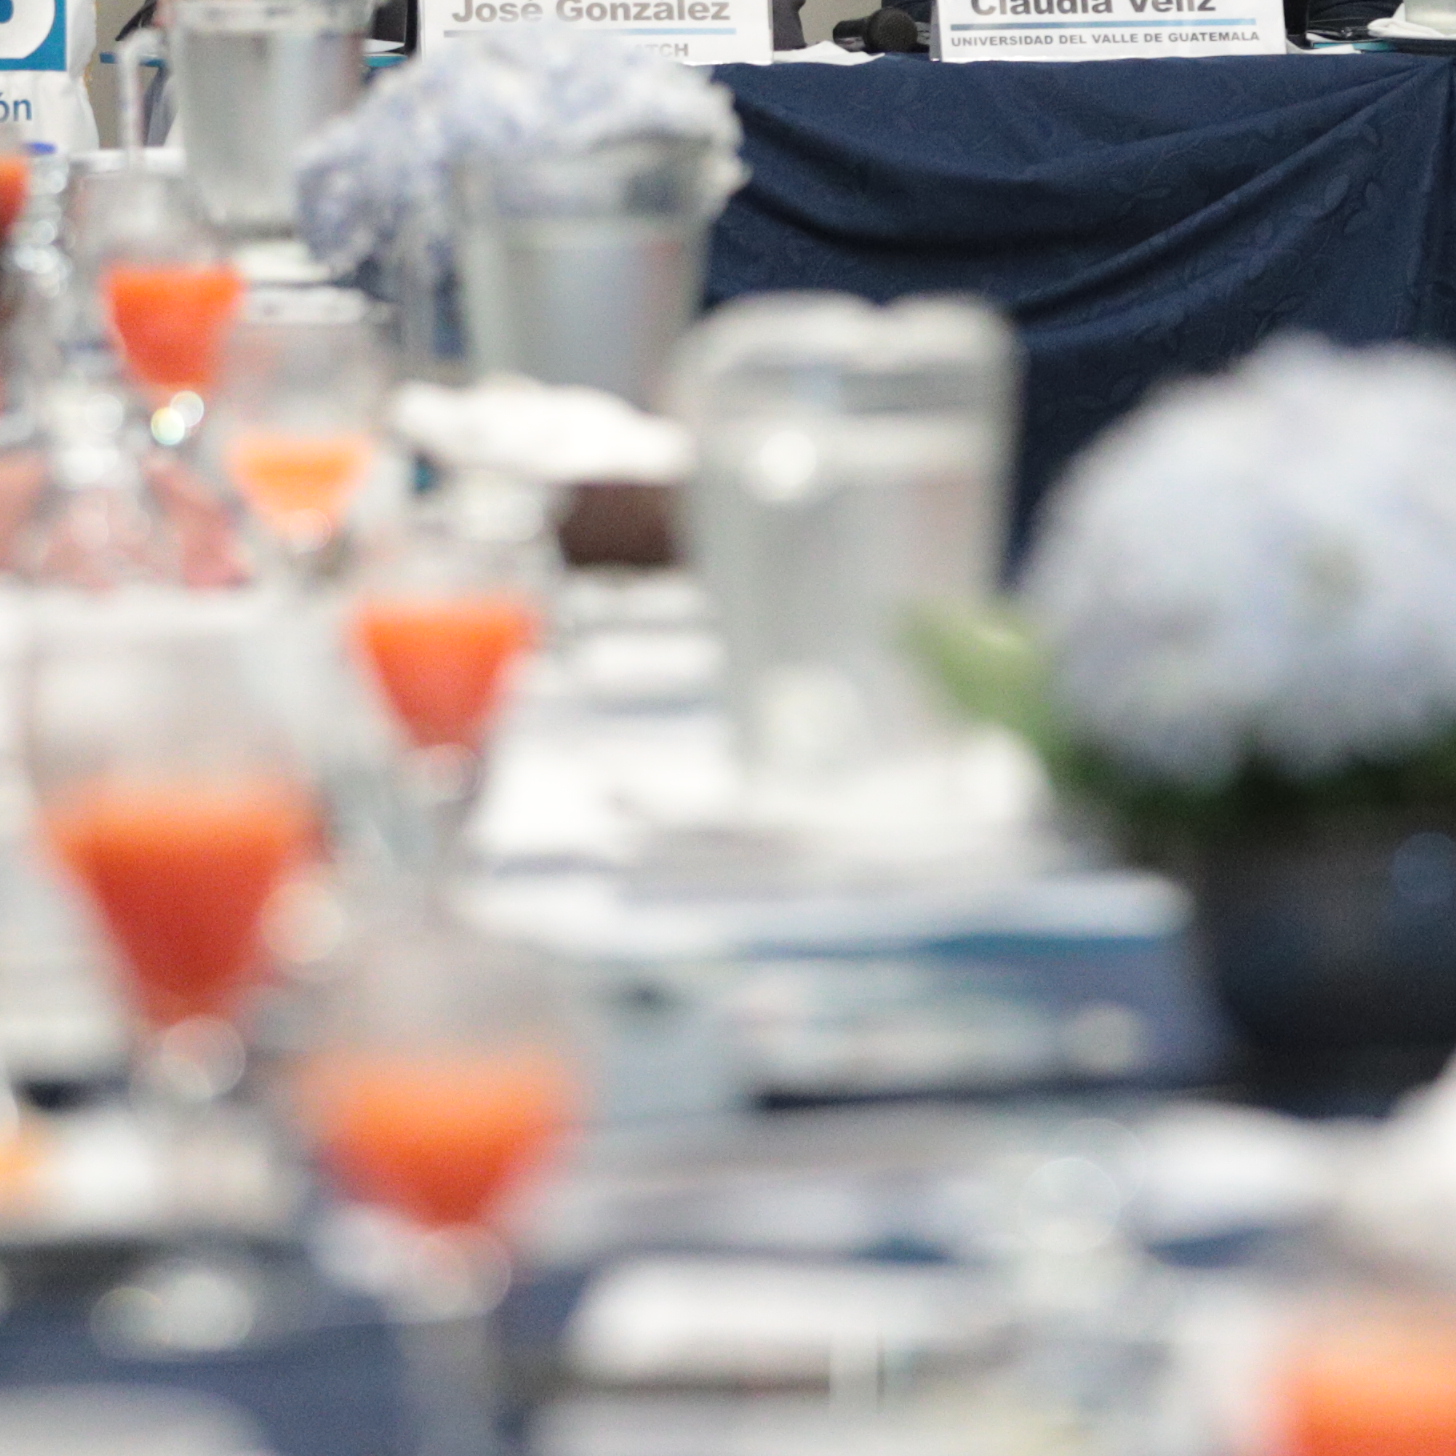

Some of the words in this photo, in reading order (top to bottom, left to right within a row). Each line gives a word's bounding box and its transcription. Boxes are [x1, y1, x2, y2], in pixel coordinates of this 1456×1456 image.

[951, 34, 1054, 47] UNIVERSIDAD
[1059, 34, 1088, 45] DEL
[1092, 33, 1140, 45] VALLE
[1144, 33, 1164, 43] DE
[1168, 31, 1261, 43] GUATEMALA
